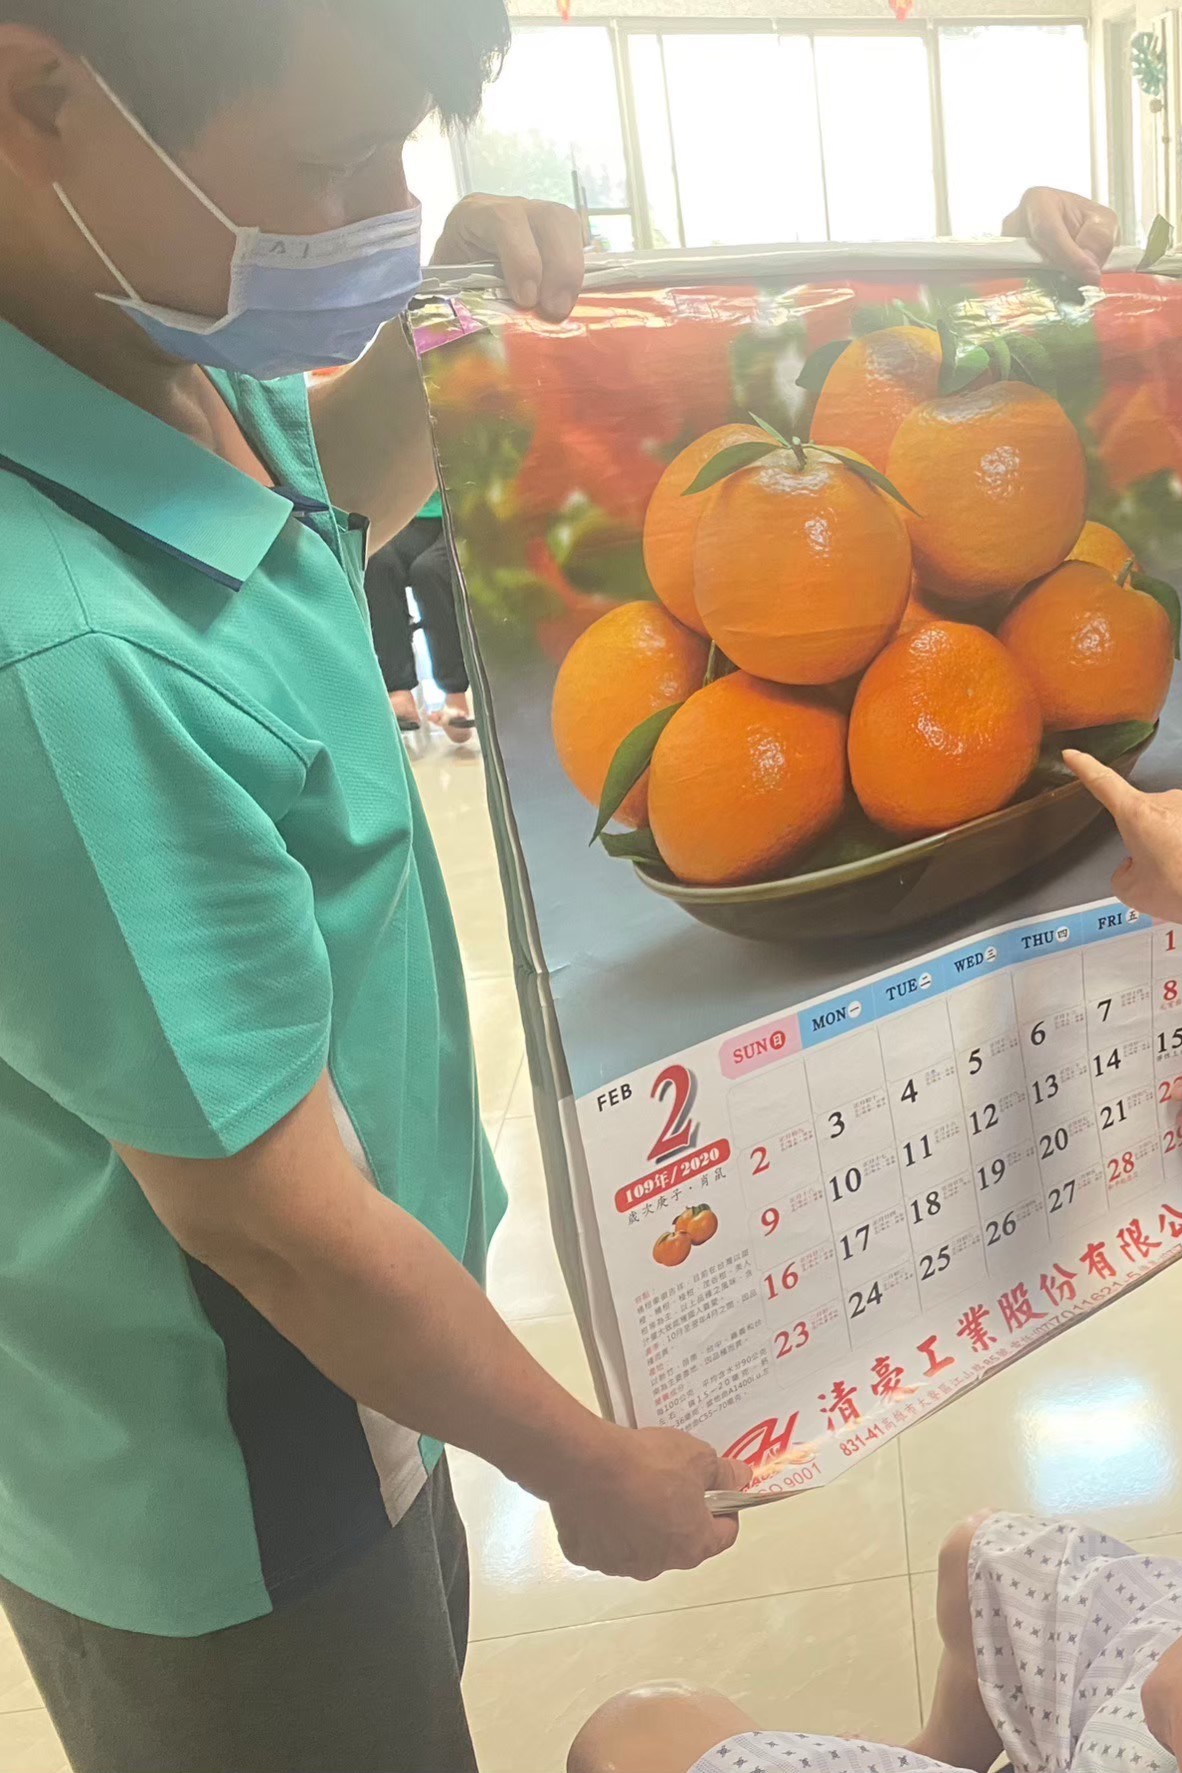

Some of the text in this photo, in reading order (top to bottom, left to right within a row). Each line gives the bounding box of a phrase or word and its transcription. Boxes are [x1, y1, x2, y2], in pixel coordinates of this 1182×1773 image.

[733, 1037, 768, 1064] SUN
[811, 1007, 847, 1032] MON
[886, 978, 918, 1001] TUE
[954, 952, 984, 973] WED
[1021, 930, 1055, 949] THU
[1097, 913, 1123, 931] FRI
[1165, 929, 1176, 952] 1
[596, 1064, 698, 1163] FEB 2
[750, 1146, 770, 1176] 2
[828, 1111, 845, 1139] 3
[900, 1078, 918, 1103] 4
[968, 1048, 983, 1075] 5
[1030, 1020, 1046, 1046] 6
[1097, 998, 1112, 1022] 7
[1163, 979, 1178, 1001] 8
[760, 1207, 780, 1237] 9
[829, 1167, 862, 1202] 10
[903, 1134, 933, 1167] 11
[969, 1103, 999, 1136] 12
[1031, 1074, 1059, 1105] 13
[1093, 1048, 1121, 1077] 14
[625, 1147, 720, 1204] 109年/2020
[763, 1261, 799, 1301] 16
[840, 1224, 870, 1261] 17
[910, 1191, 941, 1225] 18
[977, 1158, 1006, 1191] 19
[1039, 1128, 1068, 1160] 20
[1100, 1100, 1127, 1130] 21
[774, 1321, 810, 1359] 23
[849, 1281, 883, 1319] 24
[919, 1244, 951, 1281] 25
[985, 1210, 1017, 1246] 26
[1048, 1179, 1076, 1213] 27
[1107, 1151, 1135, 1183] 28
[783, 1462, 821, 1487] 9001
